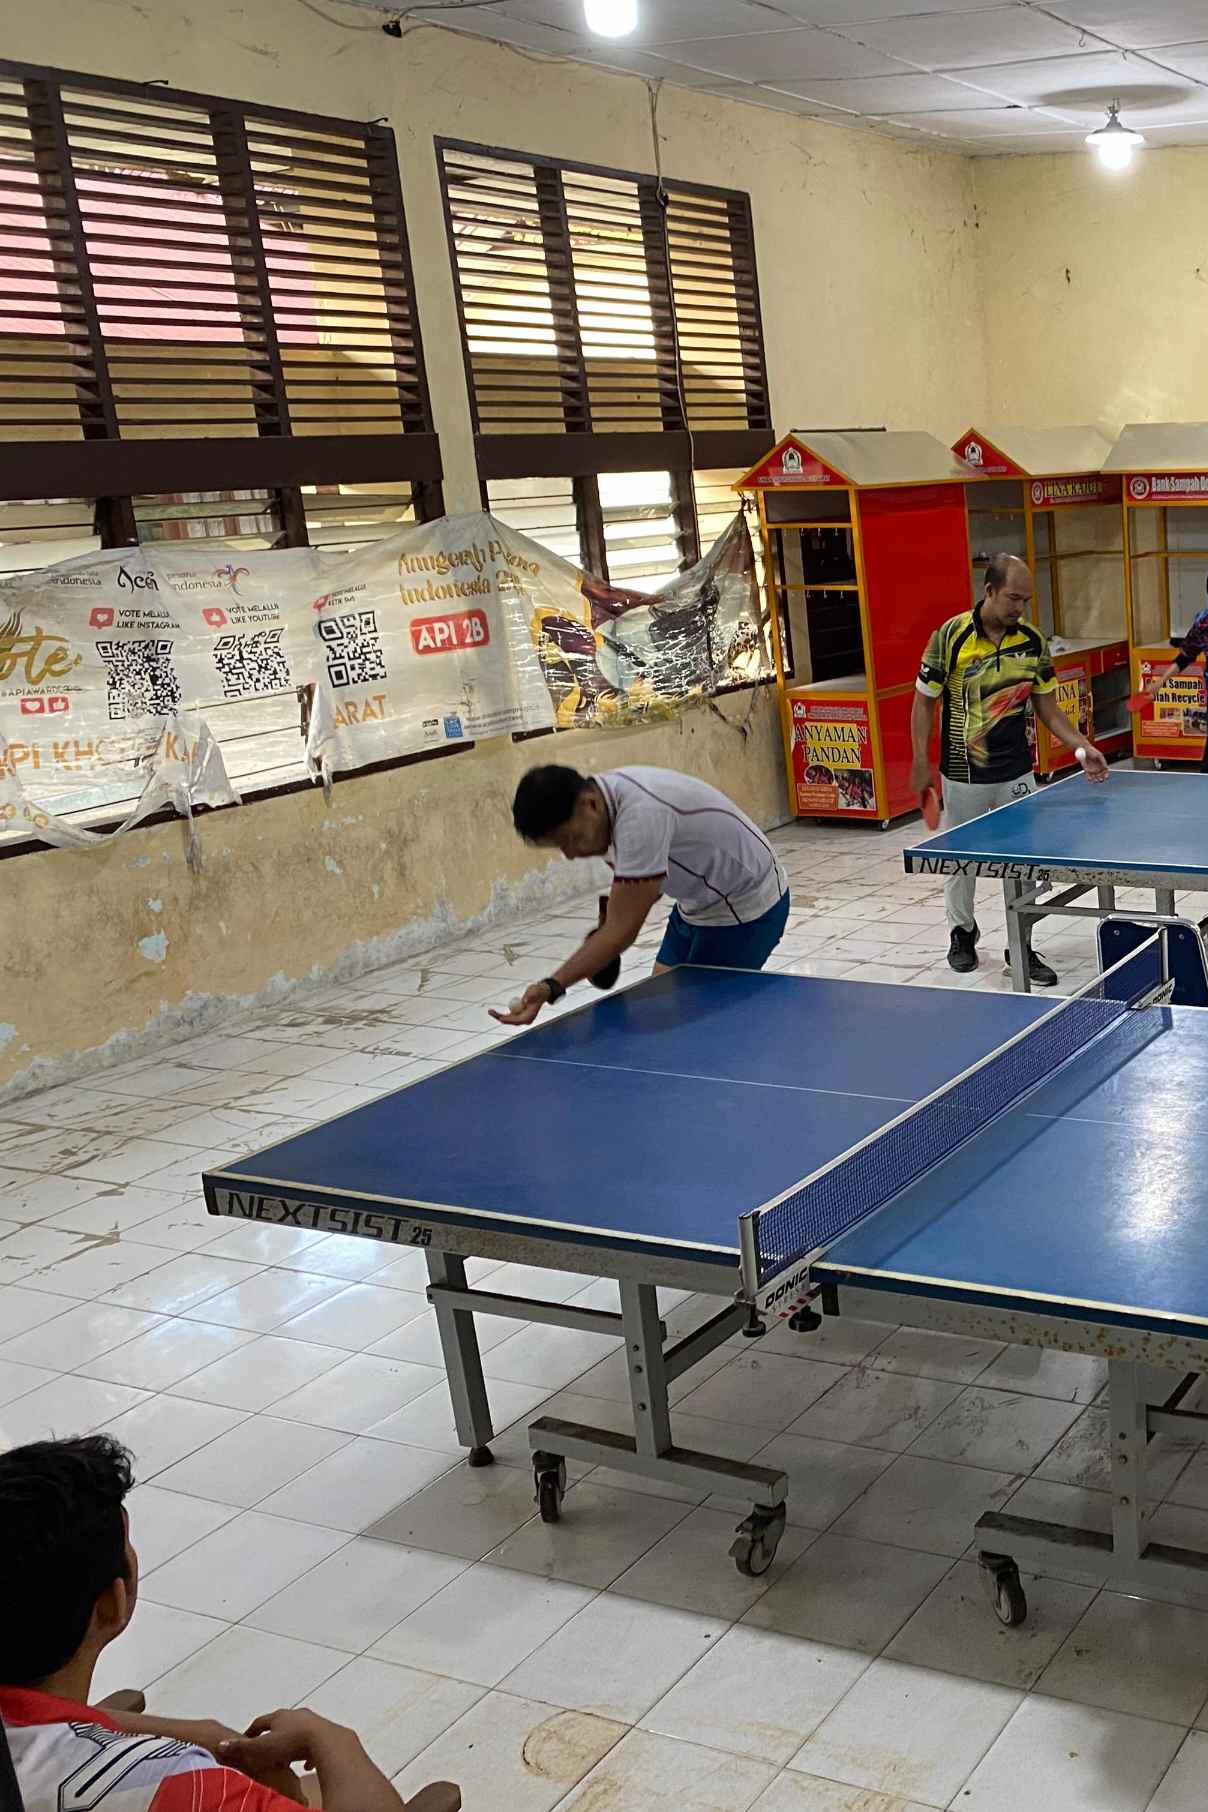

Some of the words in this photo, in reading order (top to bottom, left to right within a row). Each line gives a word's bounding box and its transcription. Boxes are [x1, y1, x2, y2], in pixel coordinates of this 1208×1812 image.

[119, 609, 140, 618] VOTE
[117, 621, 135, 629] LIKE
[418, 623, 457, 650] API
[463, 617, 484, 643] 2B
[795, 724, 867, 744] ANYAMAN
[803, 745, 861, 764] PANDAN
[919, 857, 1040, 880] NEXTSIST
[226, 1191, 409, 1243] NEXTSIST
[410, 1226, 433, 1246] 25
[765, 1266, 808, 1309] DONIC
